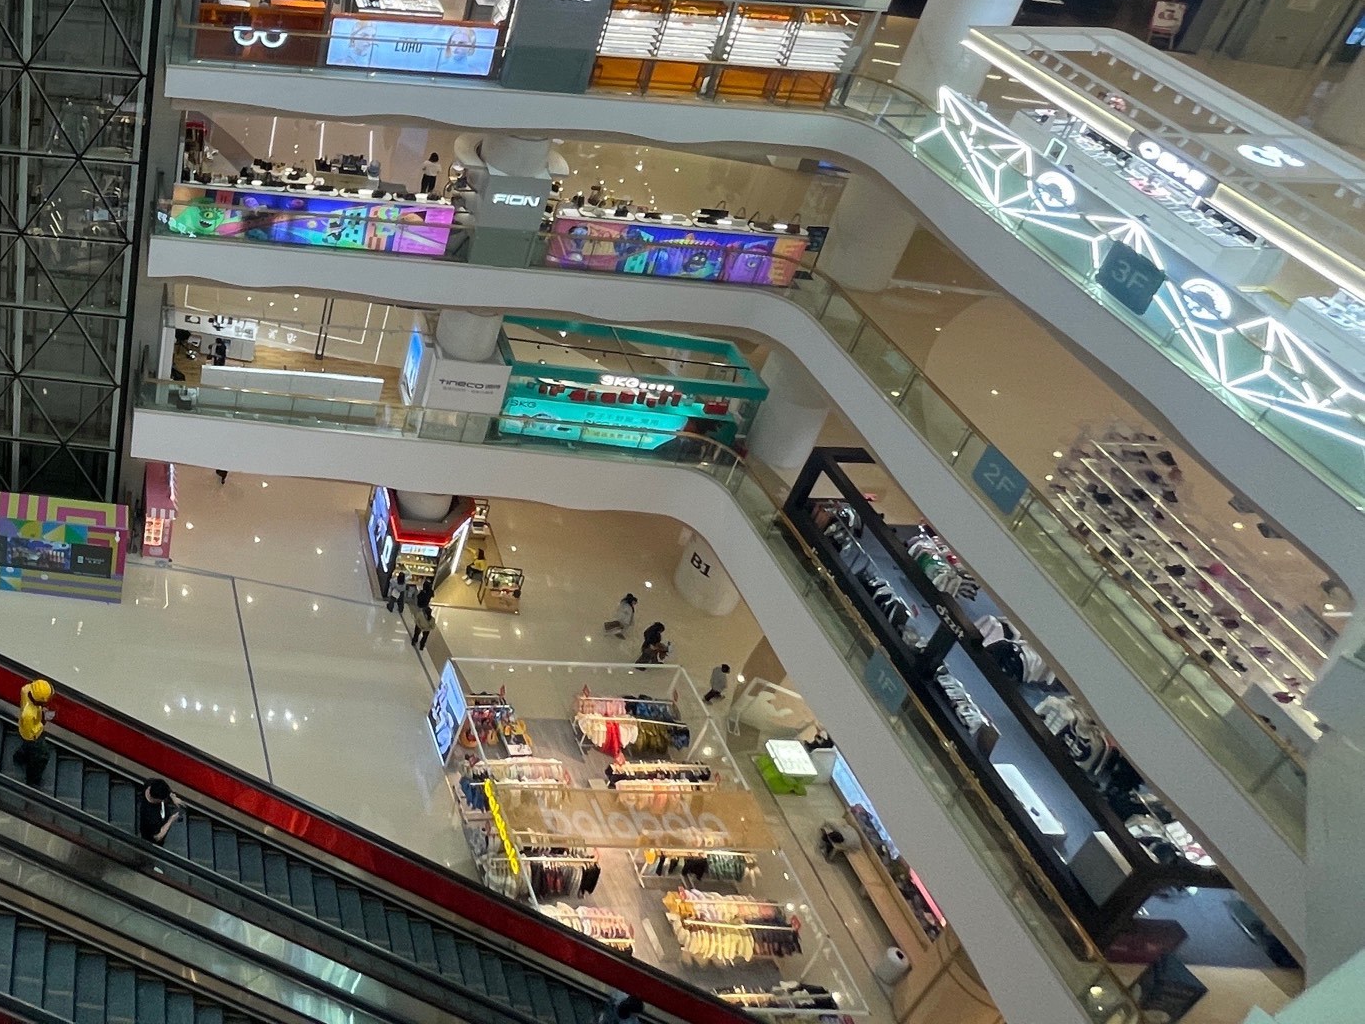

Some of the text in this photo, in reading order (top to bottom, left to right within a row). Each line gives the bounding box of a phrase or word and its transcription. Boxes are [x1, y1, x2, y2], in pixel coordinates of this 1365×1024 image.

[492, 193, 540, 207] FION
[1113, 260, 1150, 289] 3F
[601, 375, 640, 389] SKG
[983, 462, 1016, 494] 2F
[690, 551, 711, 578] B1
